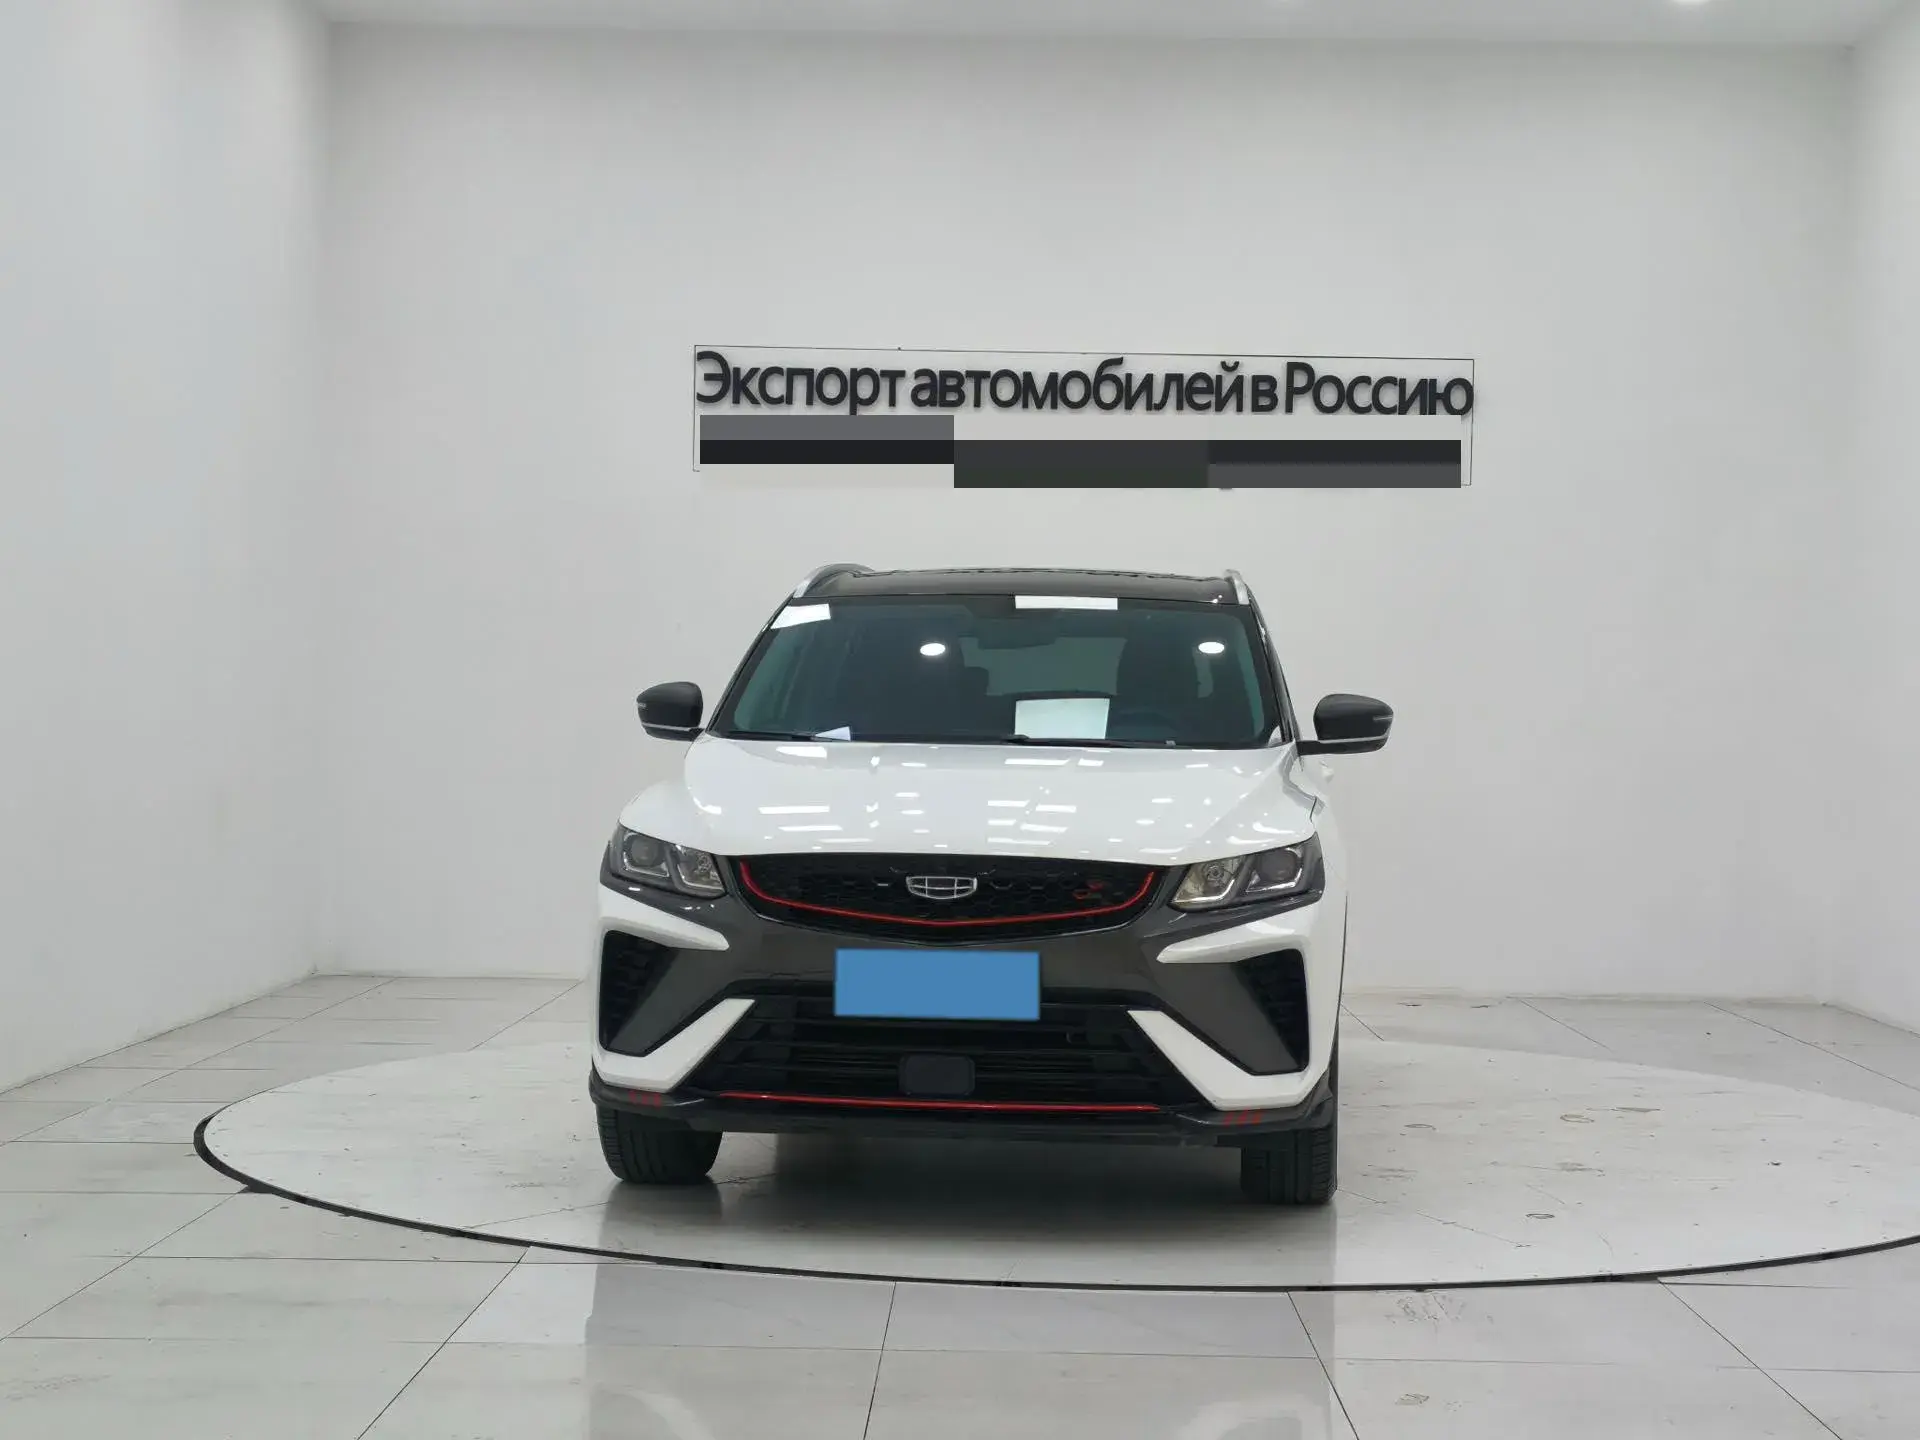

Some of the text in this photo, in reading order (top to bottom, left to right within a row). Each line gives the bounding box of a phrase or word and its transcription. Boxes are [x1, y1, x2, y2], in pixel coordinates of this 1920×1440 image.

[696, 351, 1474, 416] Экспорт автомобилей в Россию
